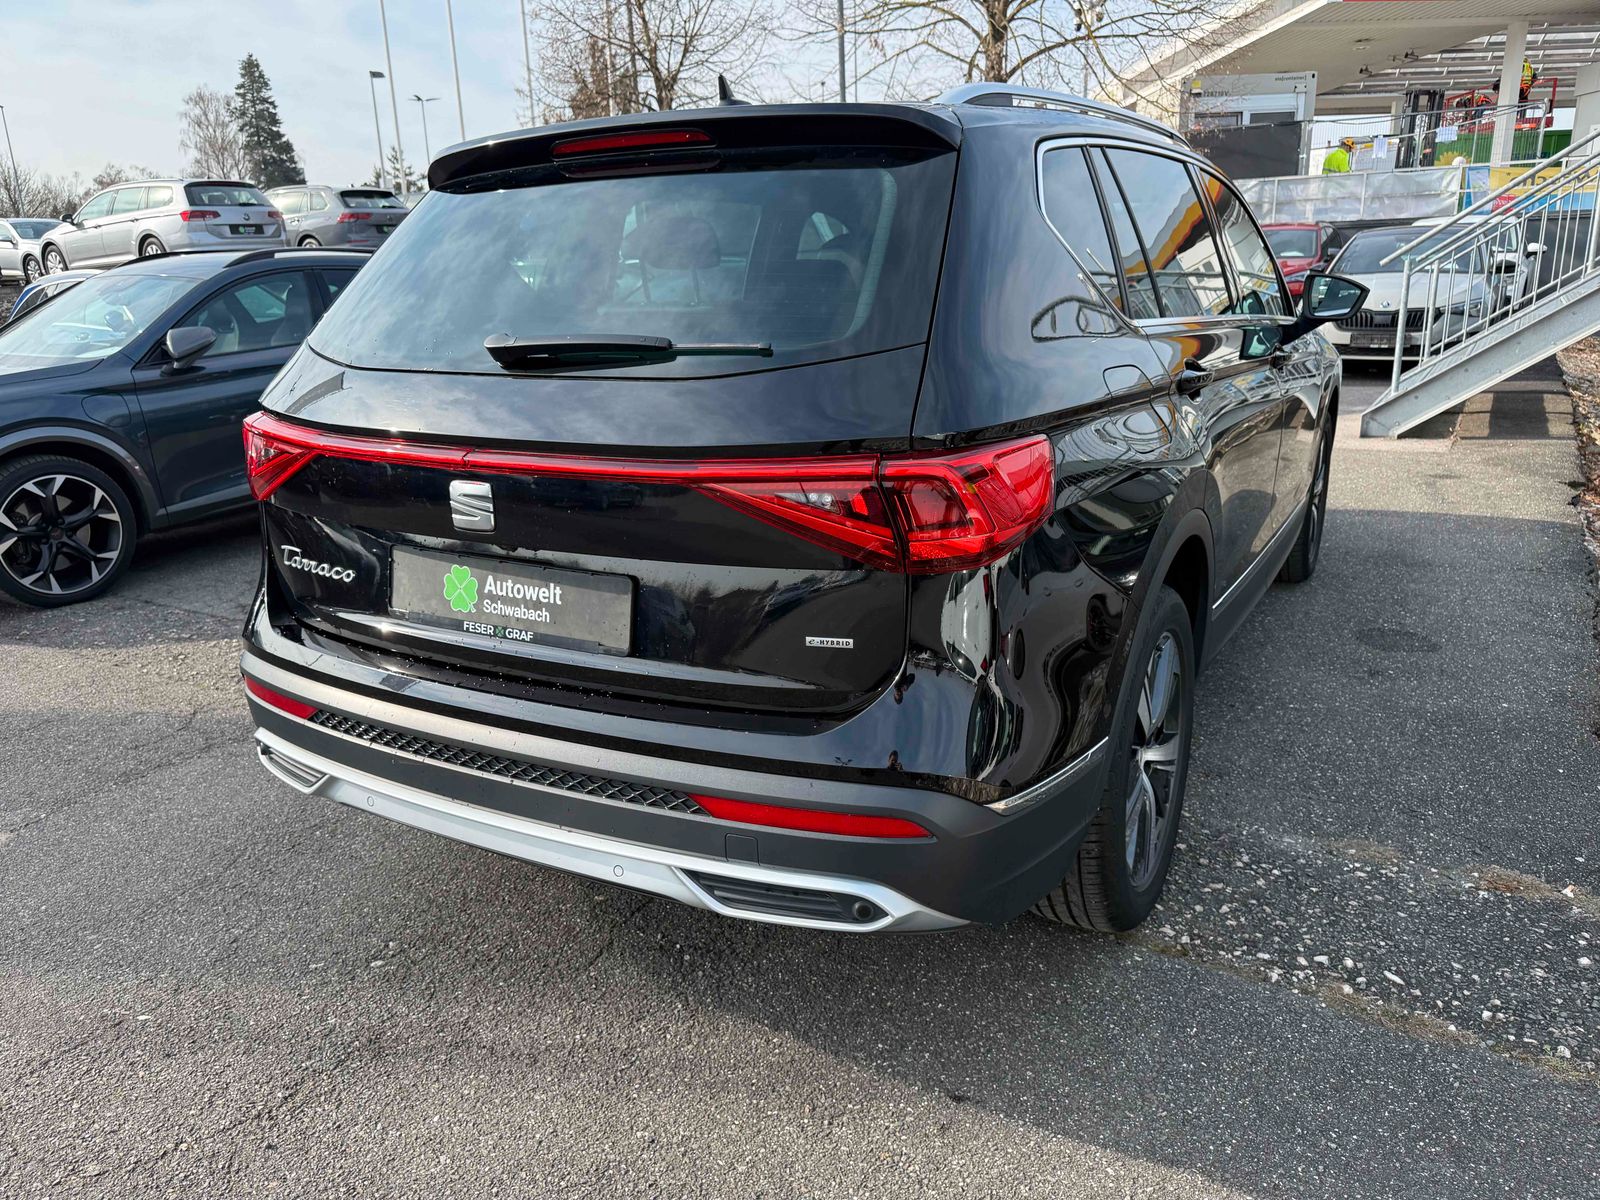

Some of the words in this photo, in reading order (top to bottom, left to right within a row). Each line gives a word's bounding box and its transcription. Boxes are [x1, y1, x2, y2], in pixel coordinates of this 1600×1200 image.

[281, 544, 356, 583] Tarraco
[484, 575, 562, 605] Autowelt
[483, 599, 550, 623] Schwabach
[463, 621, 494, 636] FESER
[505, 628, 534, 642] GRAF
